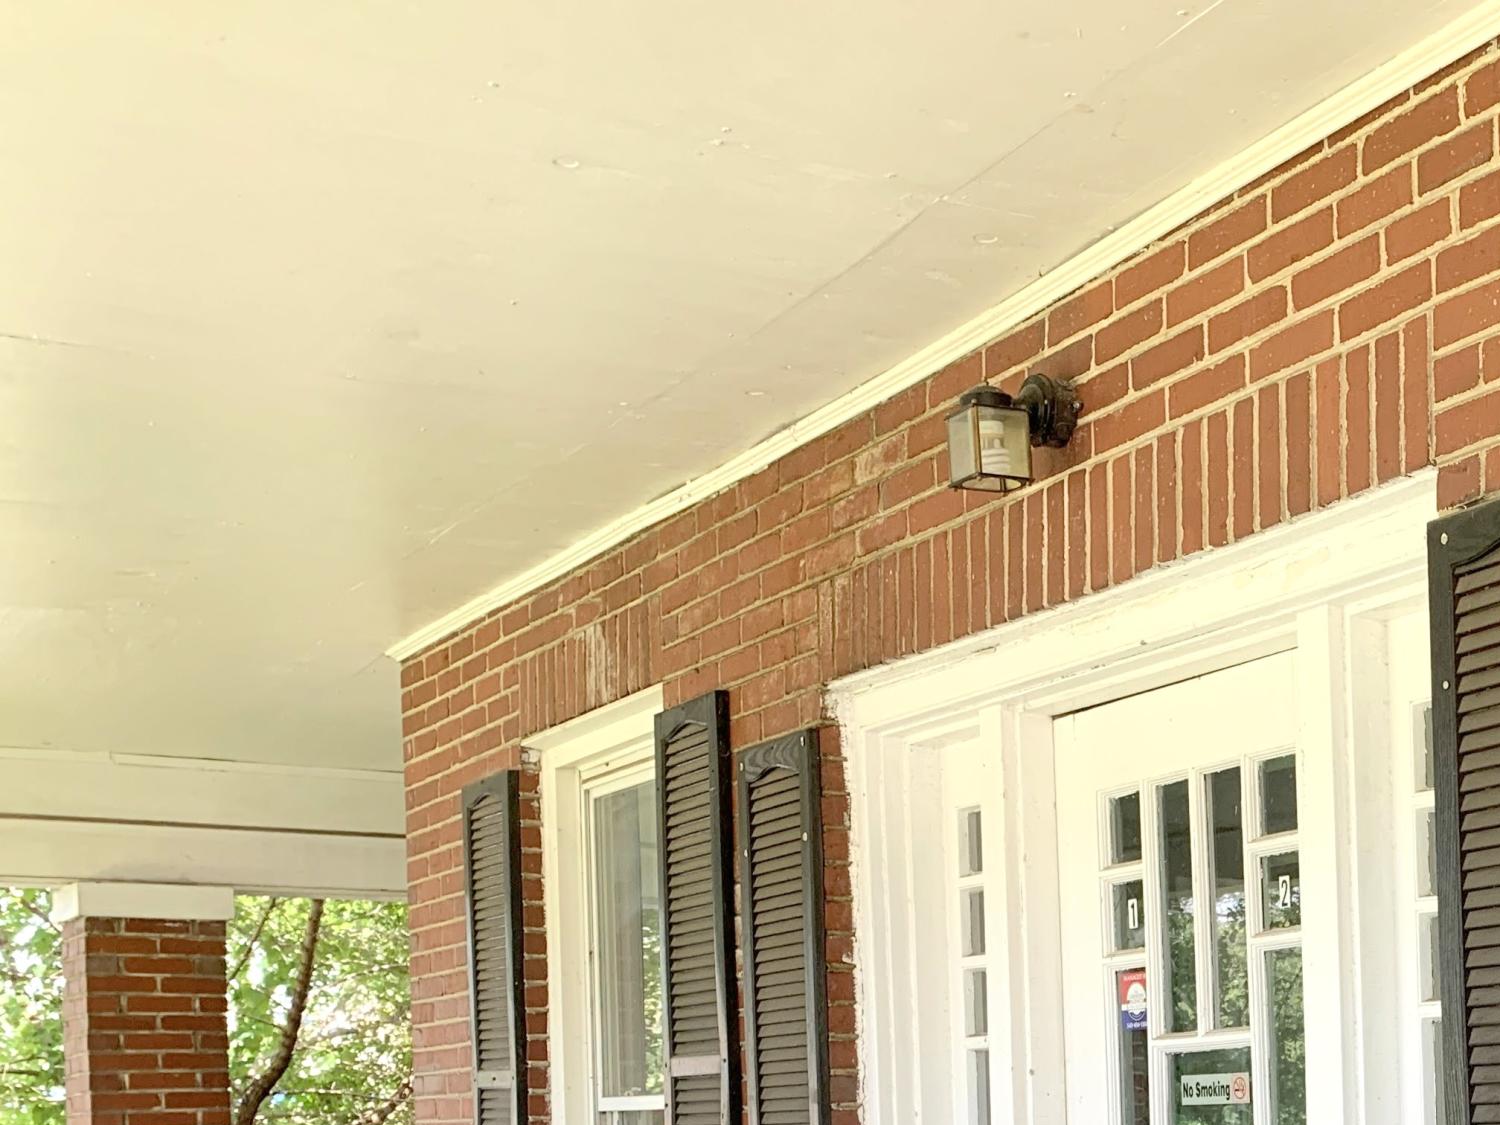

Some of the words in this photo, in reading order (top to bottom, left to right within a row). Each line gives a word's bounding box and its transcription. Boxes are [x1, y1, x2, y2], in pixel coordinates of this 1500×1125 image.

[1281, 879, 1289, 907] 2
[1183, 1082, 1194, 1098] No
[1195, 1080, 1231, 1101] Smoking
